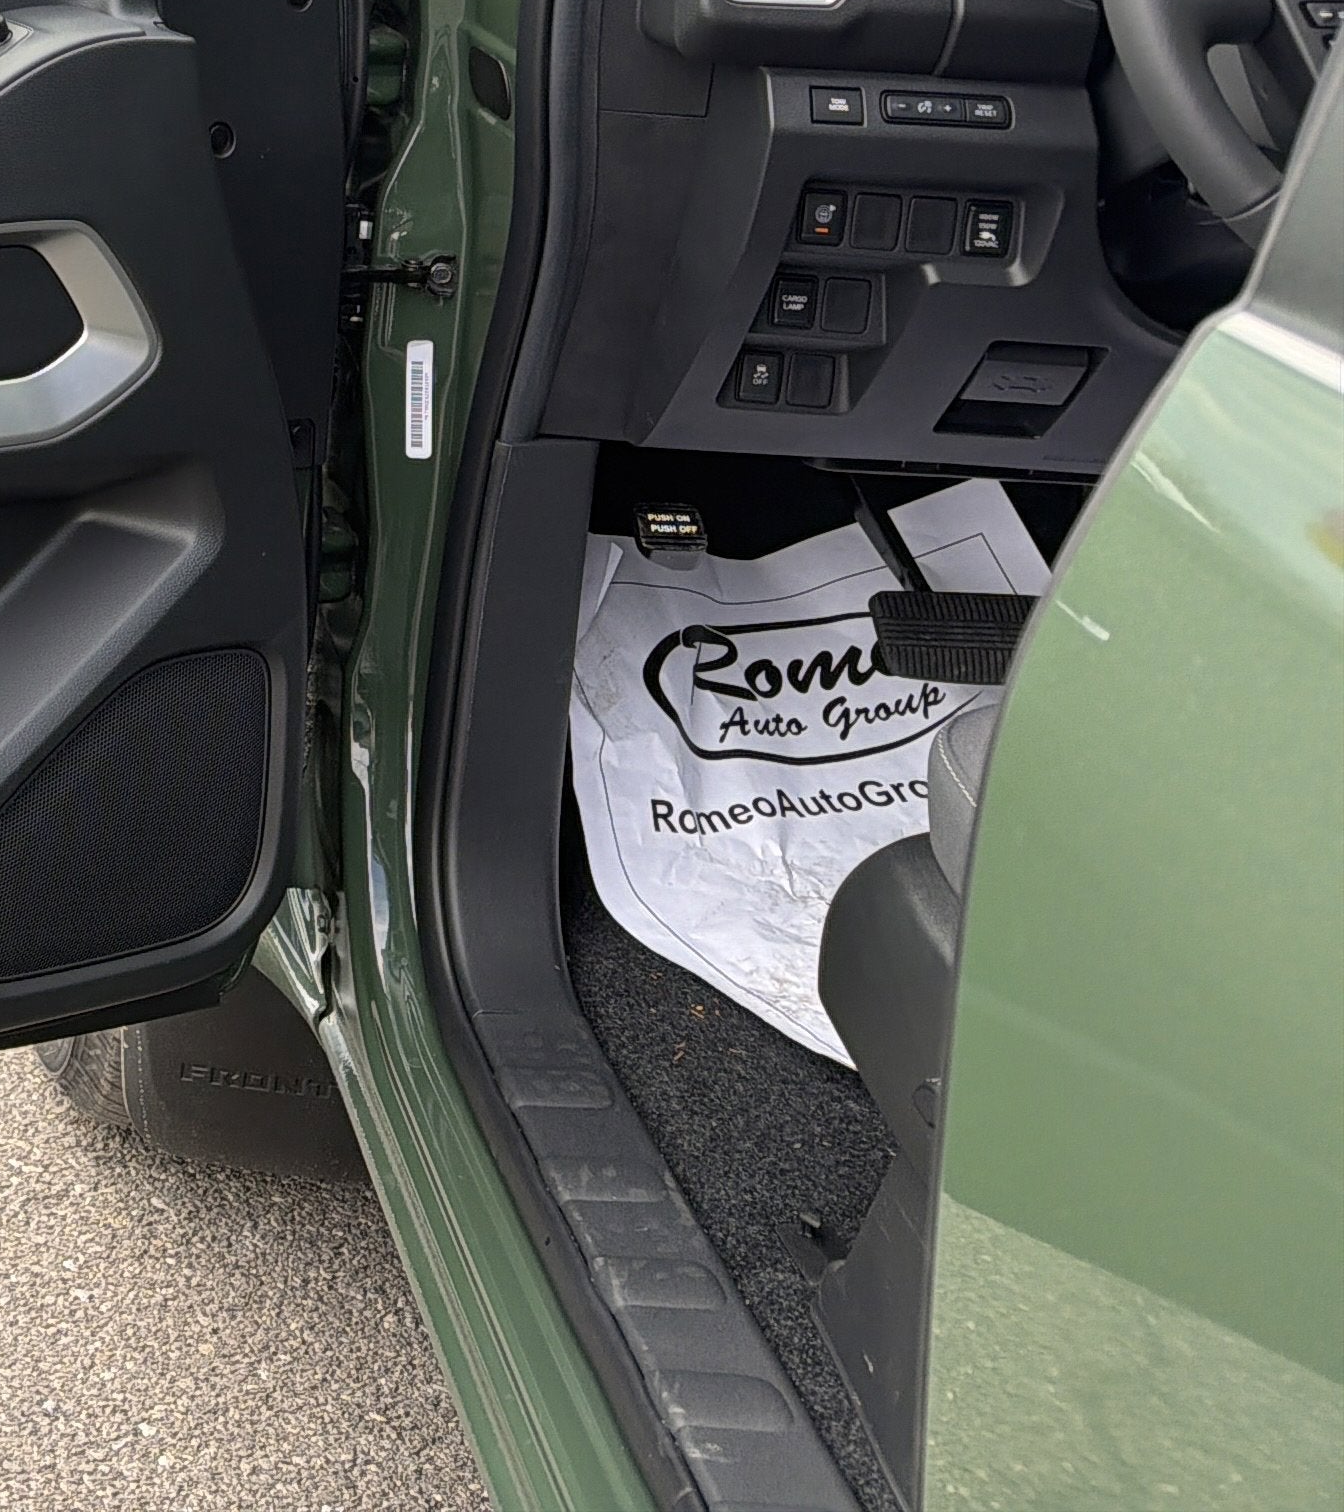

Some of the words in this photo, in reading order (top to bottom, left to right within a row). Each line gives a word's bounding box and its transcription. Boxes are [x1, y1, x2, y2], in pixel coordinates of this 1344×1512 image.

[781, 294, 808, 303] CARGO
[783, 303, 804, 311] LAMP
[647, 513, 674, 522] PUSH
[675, 514, 691, 523] ON
[650, 523, 677, 533] PUSH
[678, 525, 698, 534] OFF
[680, 624, 895, 701] Rom
[718, 705, 808, 744] Auto
[822, 682, 947, 741] Group
[651, 779, 929, 836] RomeoAutoGro
[180, 1061, 340, 1099] FRONT
